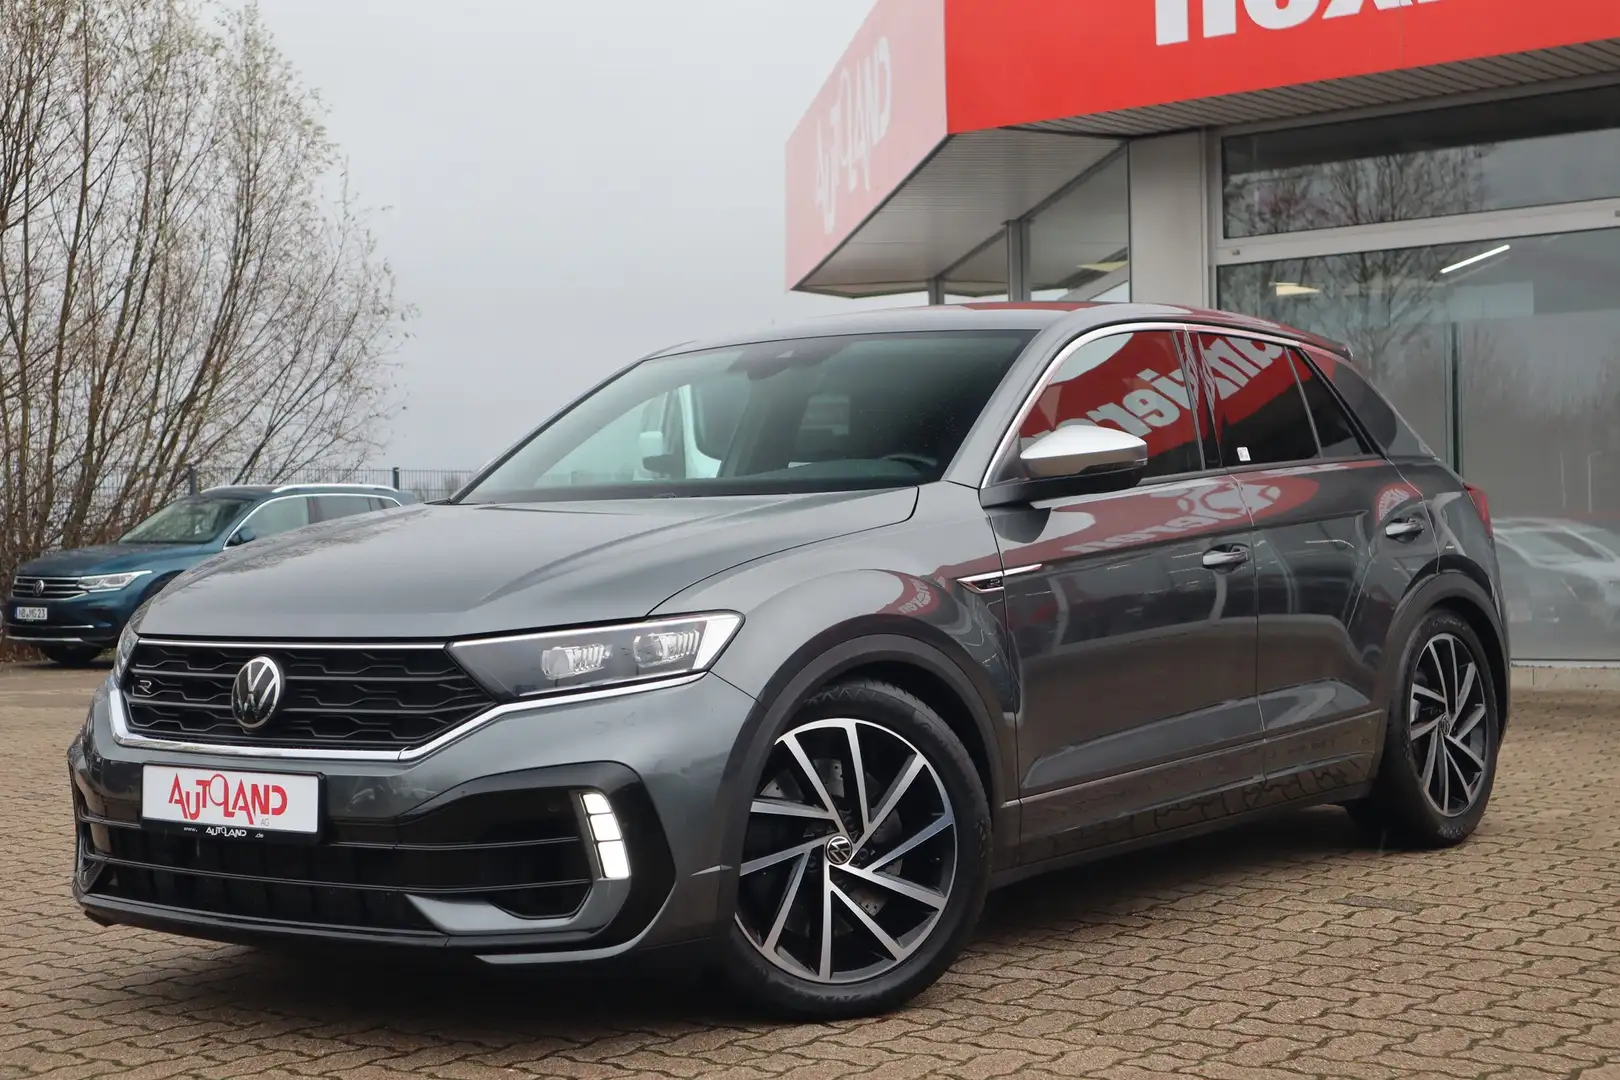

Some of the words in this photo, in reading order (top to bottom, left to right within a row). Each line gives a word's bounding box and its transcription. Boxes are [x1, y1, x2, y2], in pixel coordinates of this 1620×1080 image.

[168, 772, 288, 825] AUTOLAND
[260, 818, 270, 826] AG
[206, 826, 248, 838] AUTOLAND
